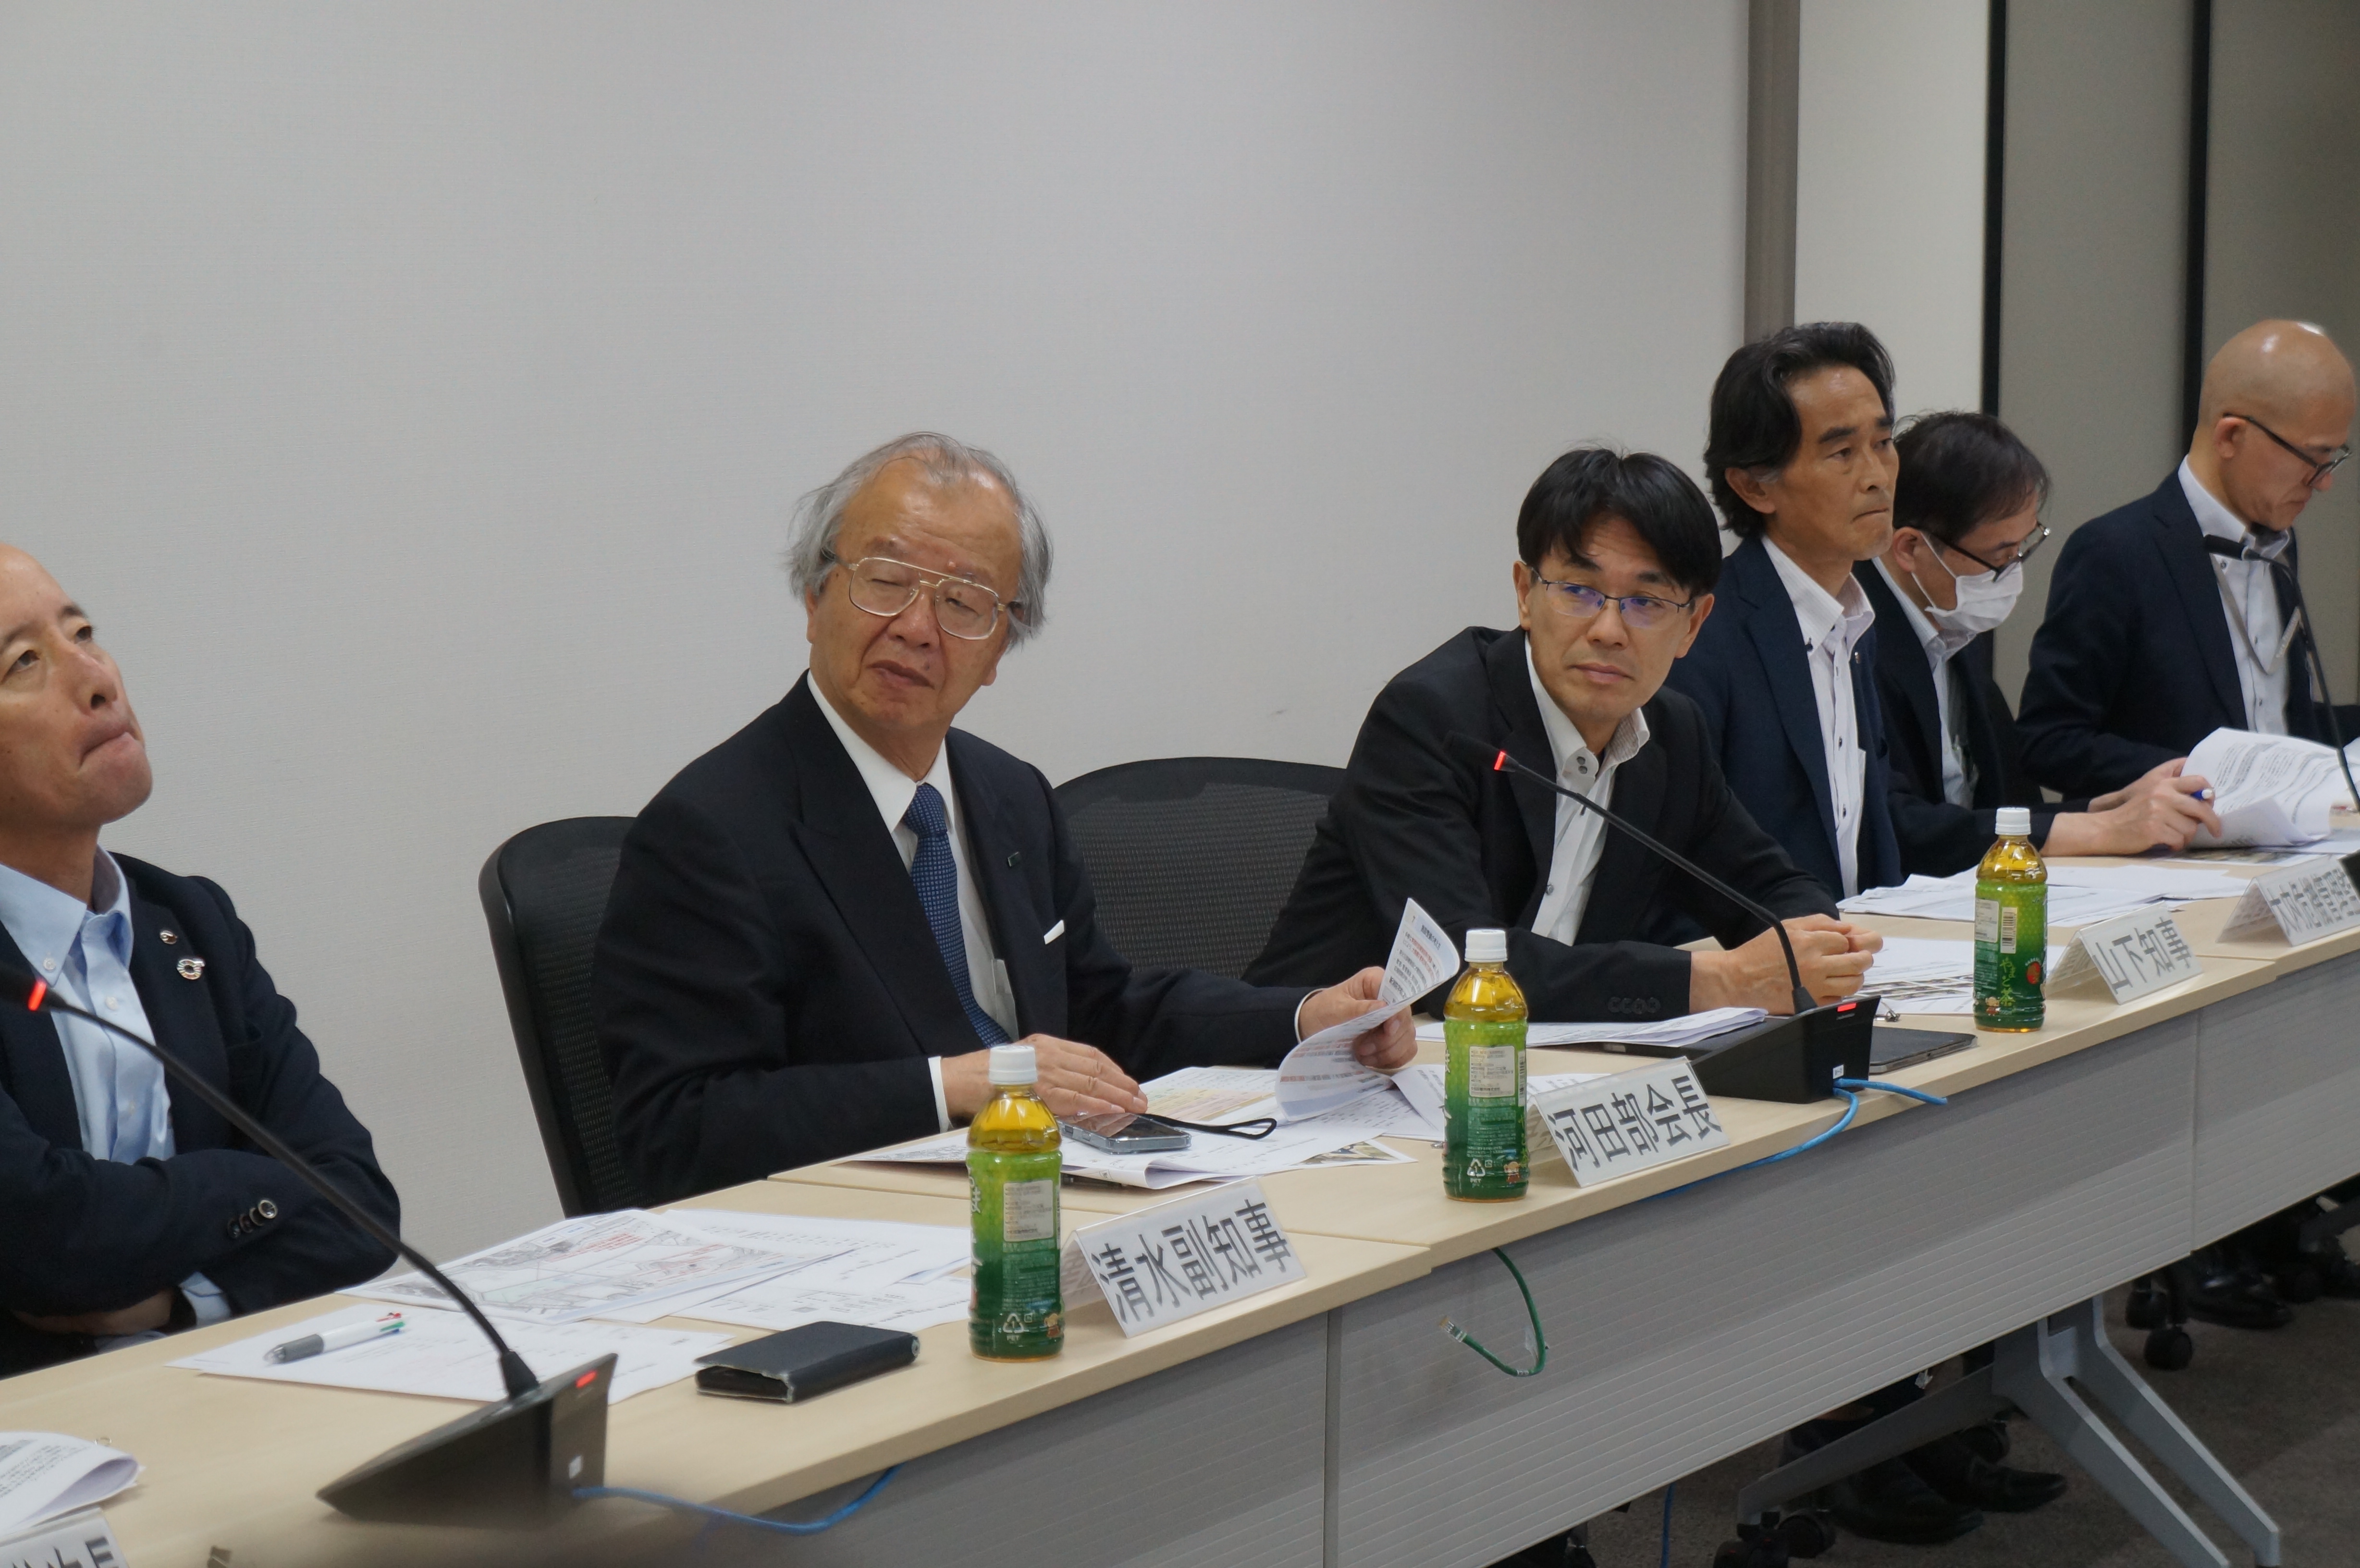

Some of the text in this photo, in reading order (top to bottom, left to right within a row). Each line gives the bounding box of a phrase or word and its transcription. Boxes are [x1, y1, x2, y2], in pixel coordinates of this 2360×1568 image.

[1999, 957, 2016, 1007] やまと茶
[2092, 917, 2192, 995] 山下知事
[1547, 1075, 1722, 1172] 河田部会長
[1091, 1199, 1291, 1324] 清水副知事
